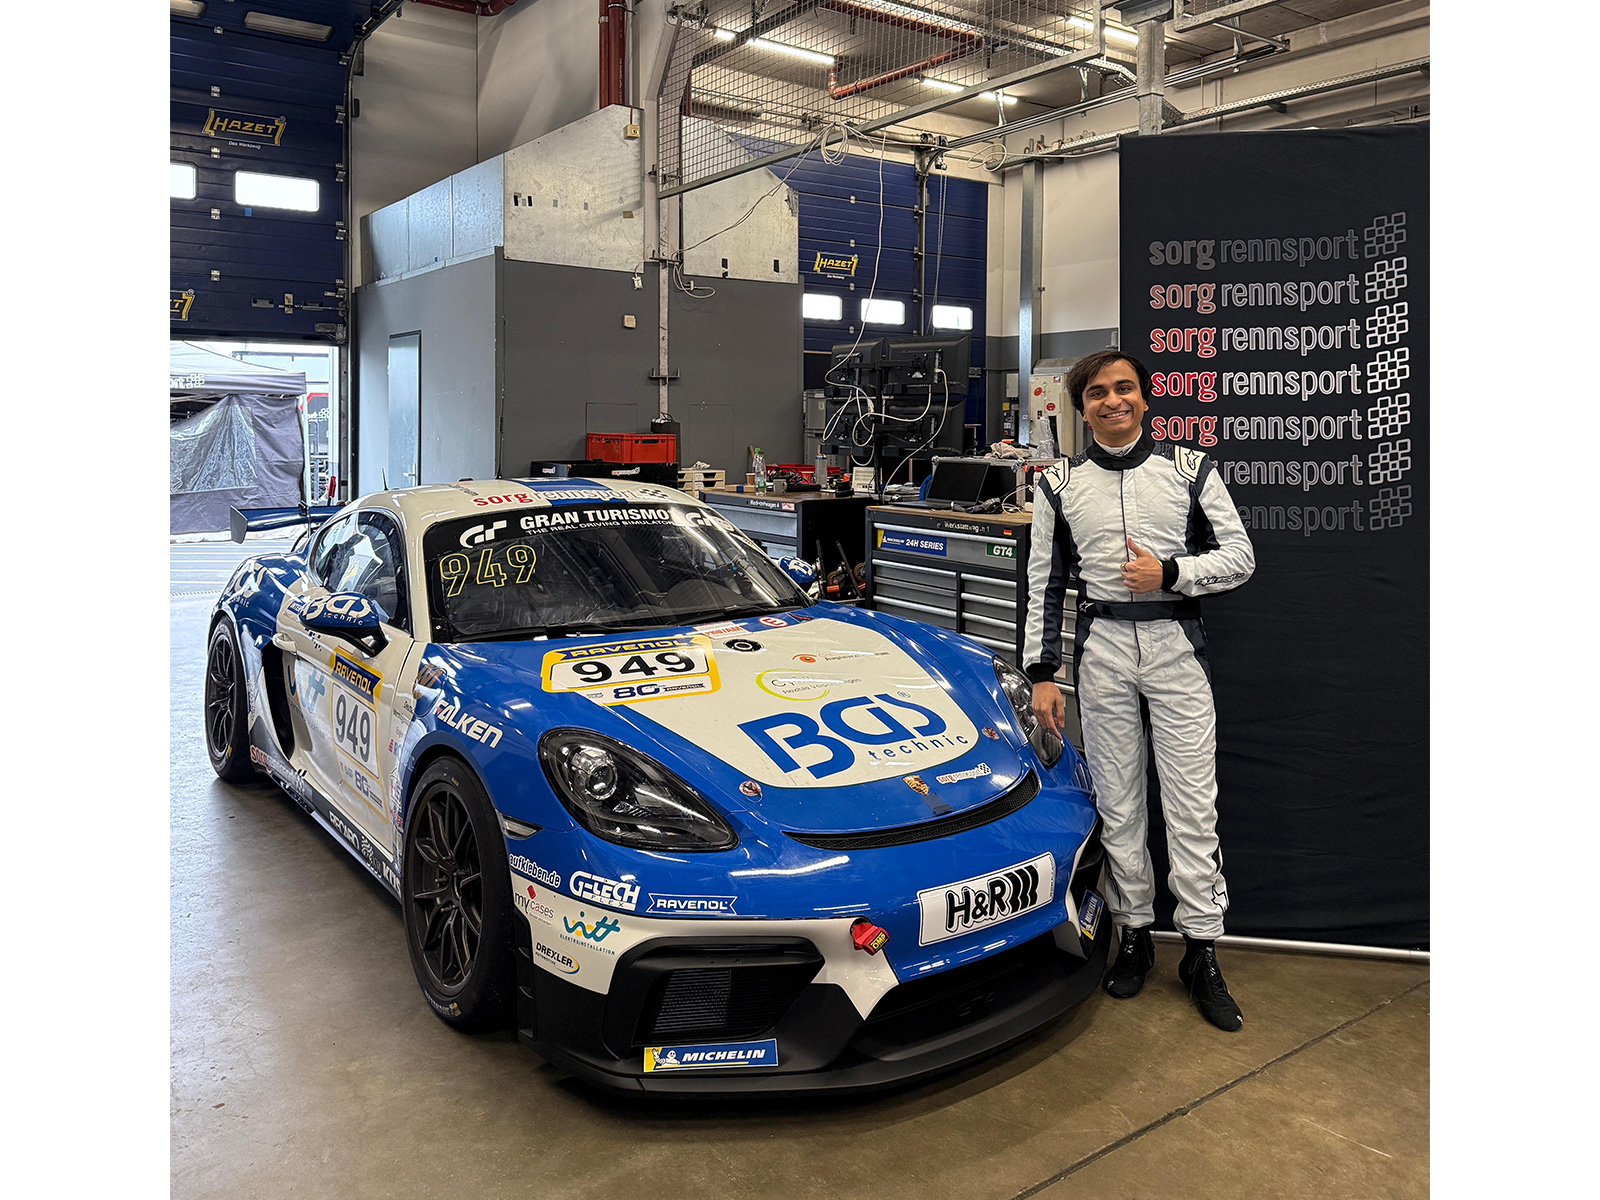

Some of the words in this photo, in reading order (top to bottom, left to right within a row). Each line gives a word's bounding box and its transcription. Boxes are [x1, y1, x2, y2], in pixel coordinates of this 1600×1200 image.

[213, 117, 276, 133] HAZET
[819, 258, 852, 268] HAZET
[1149, 239, 1215, 270] sorg
[1221, 229, 1358, 266] rennsport
[1149, 283, 1216, 314] sorg
[1221, 273, 1359, 311] rennsport
[1150, 326, 1217, 358] sorg
[1222, 319, 1360, 356] rennsport
[1151, 371, 1217, 402] sorg
[1222, 364, 1361, 401] rennsport
[1151, 414, 1217, 446] sorg
[1223, 409, 1362, 446] rennsport
[1224, 455, 1363, 491] rennsport
[472, 491, 534, 506] sorg
[535, 488, 638, 501] rennsport
[519, 511, 580, 531] GRAN
[588, 508, 670, 523] TURISMO
[620, 518, 675, 527] SIMULATOR
[1238, 500, 1364, 536] ennsport
[905, 538, 919, 547] 24H
[919, 540, 944, 551] SERIES
[993, 545, 1013, 557] GT4
[438, 545, 538, 598] 949
[323, 611, 364, 626] technic
[569, 639, 690, 657] RAVENOL
[335, 661, 372, 695] RAVENOL
[572, 651, 695, 683] 949
[613, 684, 660, 700] 80
[335, 694, 371, 763] 949
[433, 699, 504, 749] FALKEN
[737, 693, 947, 780] BGS
[250, 745, 272, 773] sorg
[868, 733, 969, 761] technic
[508, 852, 562, 889] aufkleben.de
[656, 898, 729, 910] RAVENOL
[946, 876, 1010, 932] H&R
[1084, 896, 1098, 923] MICHELIN
[559, 933, 616, 956] ELEKTROINSTALLATION
[872, 933, 886, 949] OMP
[681, 1048, 766, 1062] MICHELIN
